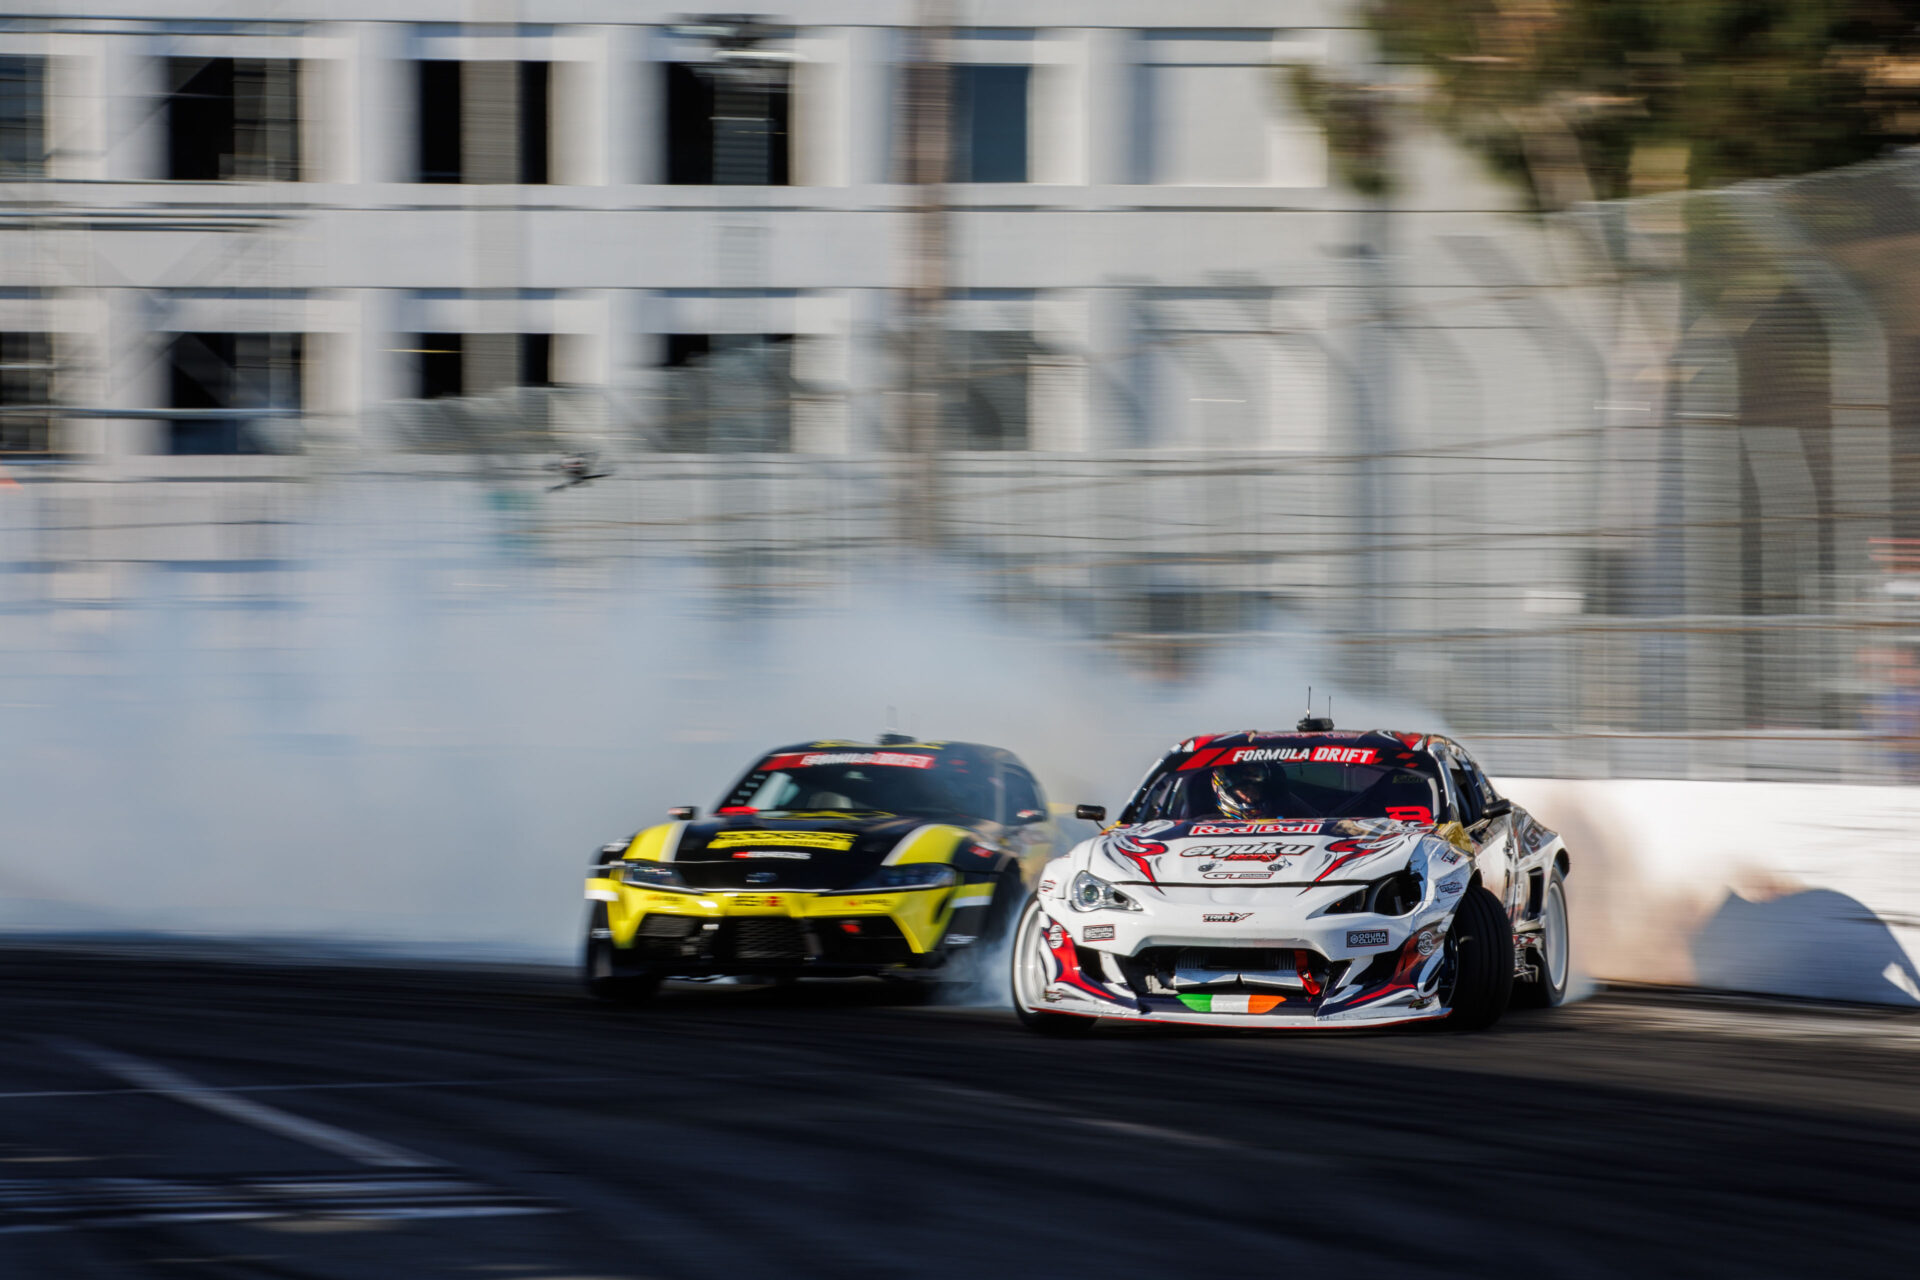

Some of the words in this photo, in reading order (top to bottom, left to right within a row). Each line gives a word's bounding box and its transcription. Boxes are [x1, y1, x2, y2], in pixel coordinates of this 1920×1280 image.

[1232, 748, 1310, 762] FORMULA
[1312, 748, 1374, 763] DRIFT
[1190, 825, 1254, 835] Red
[1258, 824, 1322, 834] Bull
[1179, 842, 1315, 859] enjuku
